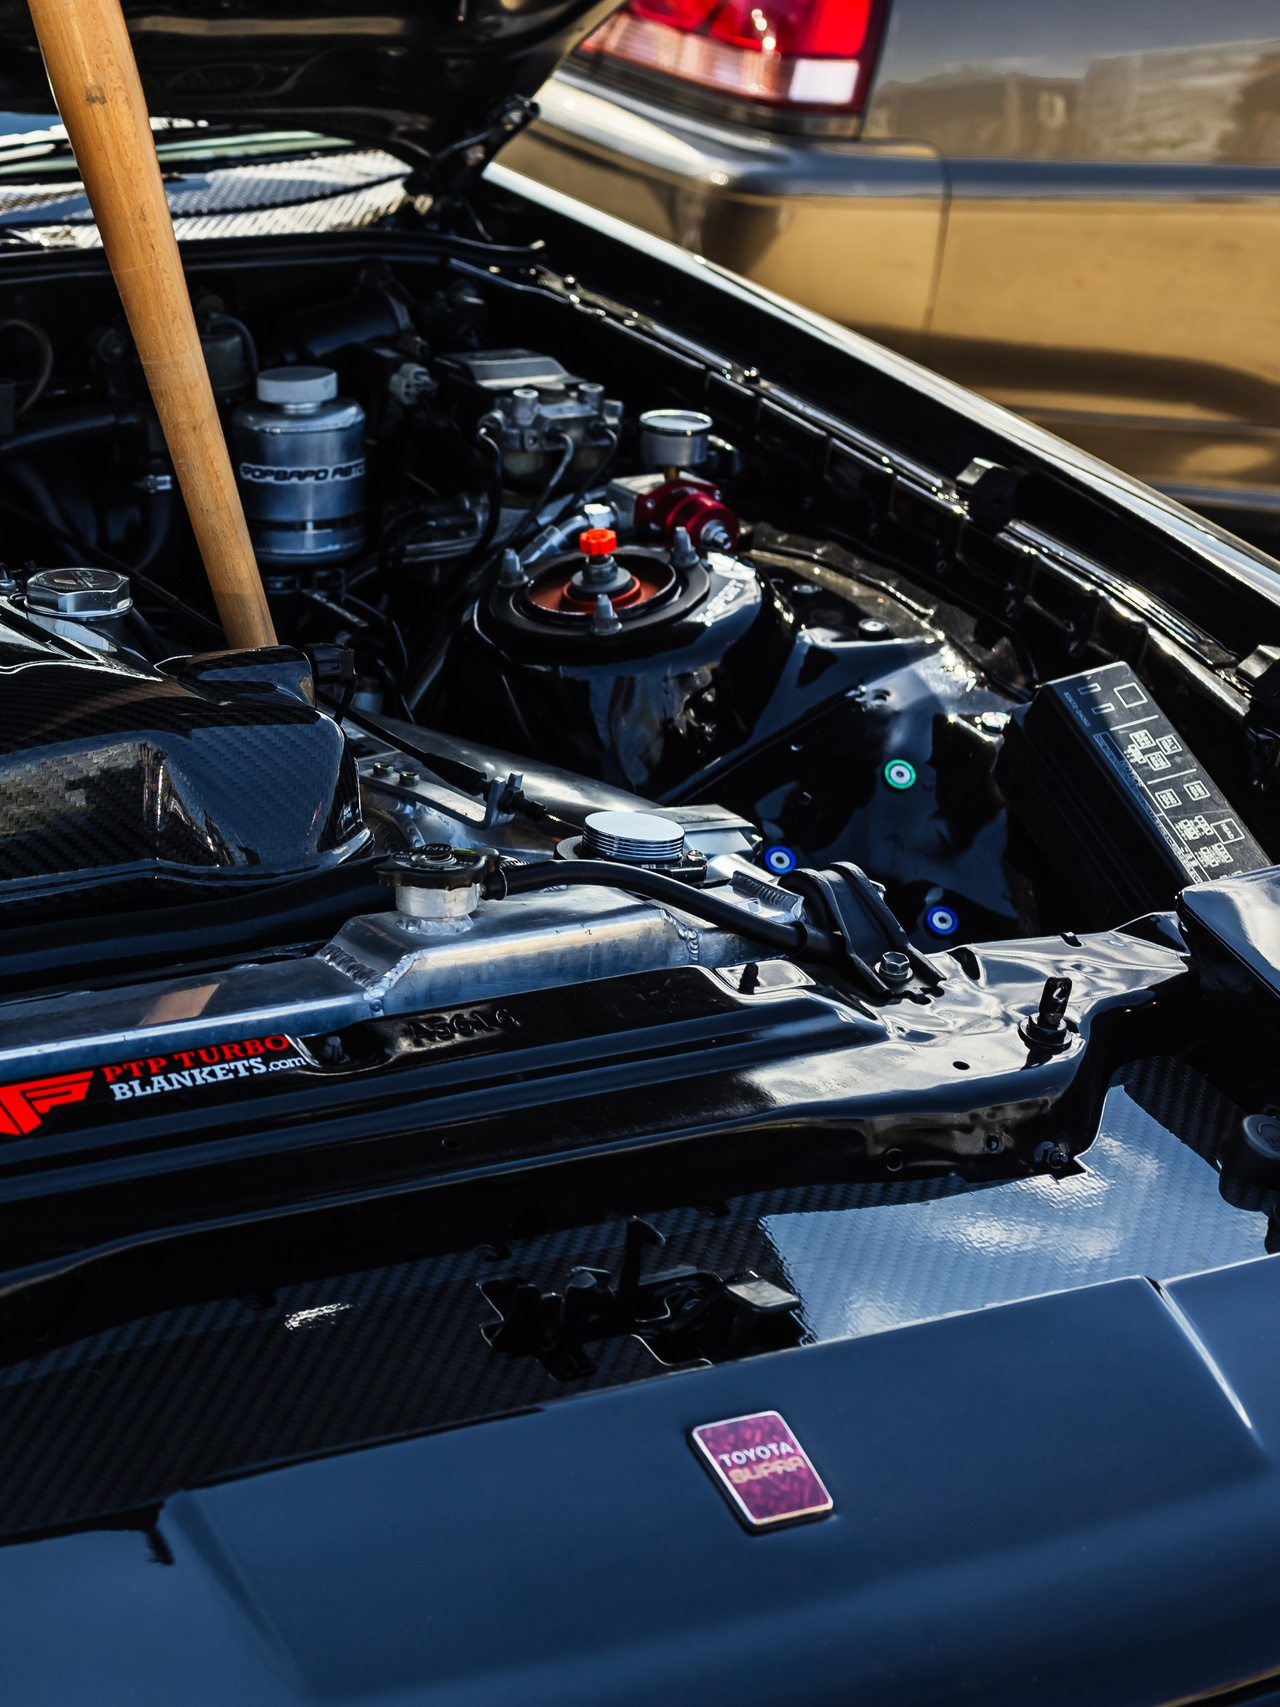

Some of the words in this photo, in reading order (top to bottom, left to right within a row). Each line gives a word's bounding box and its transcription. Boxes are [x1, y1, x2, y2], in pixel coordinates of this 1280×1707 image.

[101, 1057, 147, 1083] PTP
[174, 1034, 289, 1068] TURBO
[110, 1055, 306, 1101] BLANKETS.com
[718, 1441, 795, 1467] TOYOTA
[728, 1456, 806, 1484] SUPRA
